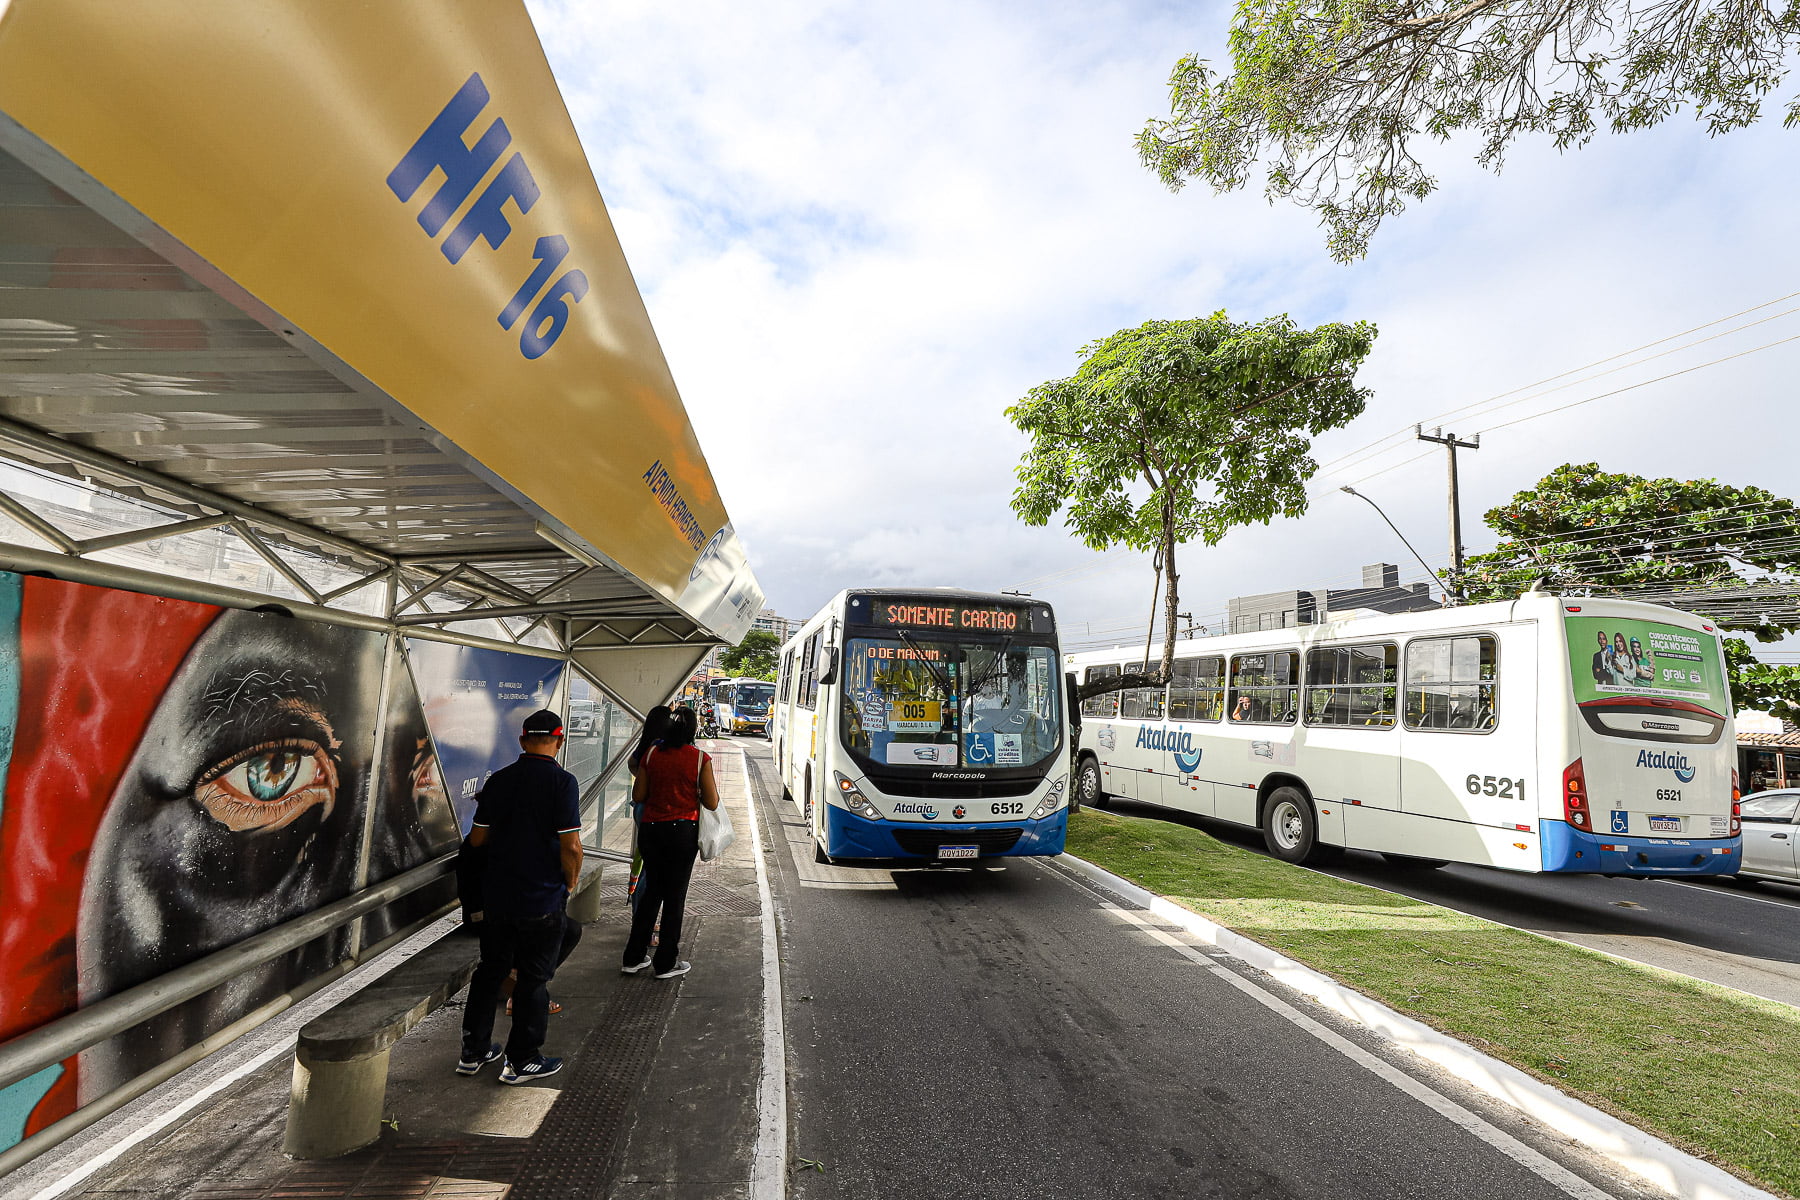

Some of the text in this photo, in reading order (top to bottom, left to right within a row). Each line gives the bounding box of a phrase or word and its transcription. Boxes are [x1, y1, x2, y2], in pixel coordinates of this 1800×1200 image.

[386, 72, 589, 359] HF 16
[642, 460, 706, 551] AVENIDA HERMES FONTES
[887, 605, 1016, 629] SOMENTE CARTAO
[1649, 632, 1672, 641] CURSOS
[1651, 640, 1669, 651] FAÇA
[1670, 642, 1680, 651] NO
[878, 648, 895, 659] DE
[1663, 669, 1685, 681] grau
[904, 704, 926, 718] 005
[1648, 722, 1679, 730] Marcopolo
[1136, 724, 1196, 754] Atalaia
[1636, 749, 1691, 771] Atalaia
[932, 772, 986, 780] Marcopolo
[1466, 774, 1525, 800] 6521
[1656, 788, 1681, 801] 6521
[893, 803, 935, 814] Atalaia
[990, 803, 1023, 815] 6512
